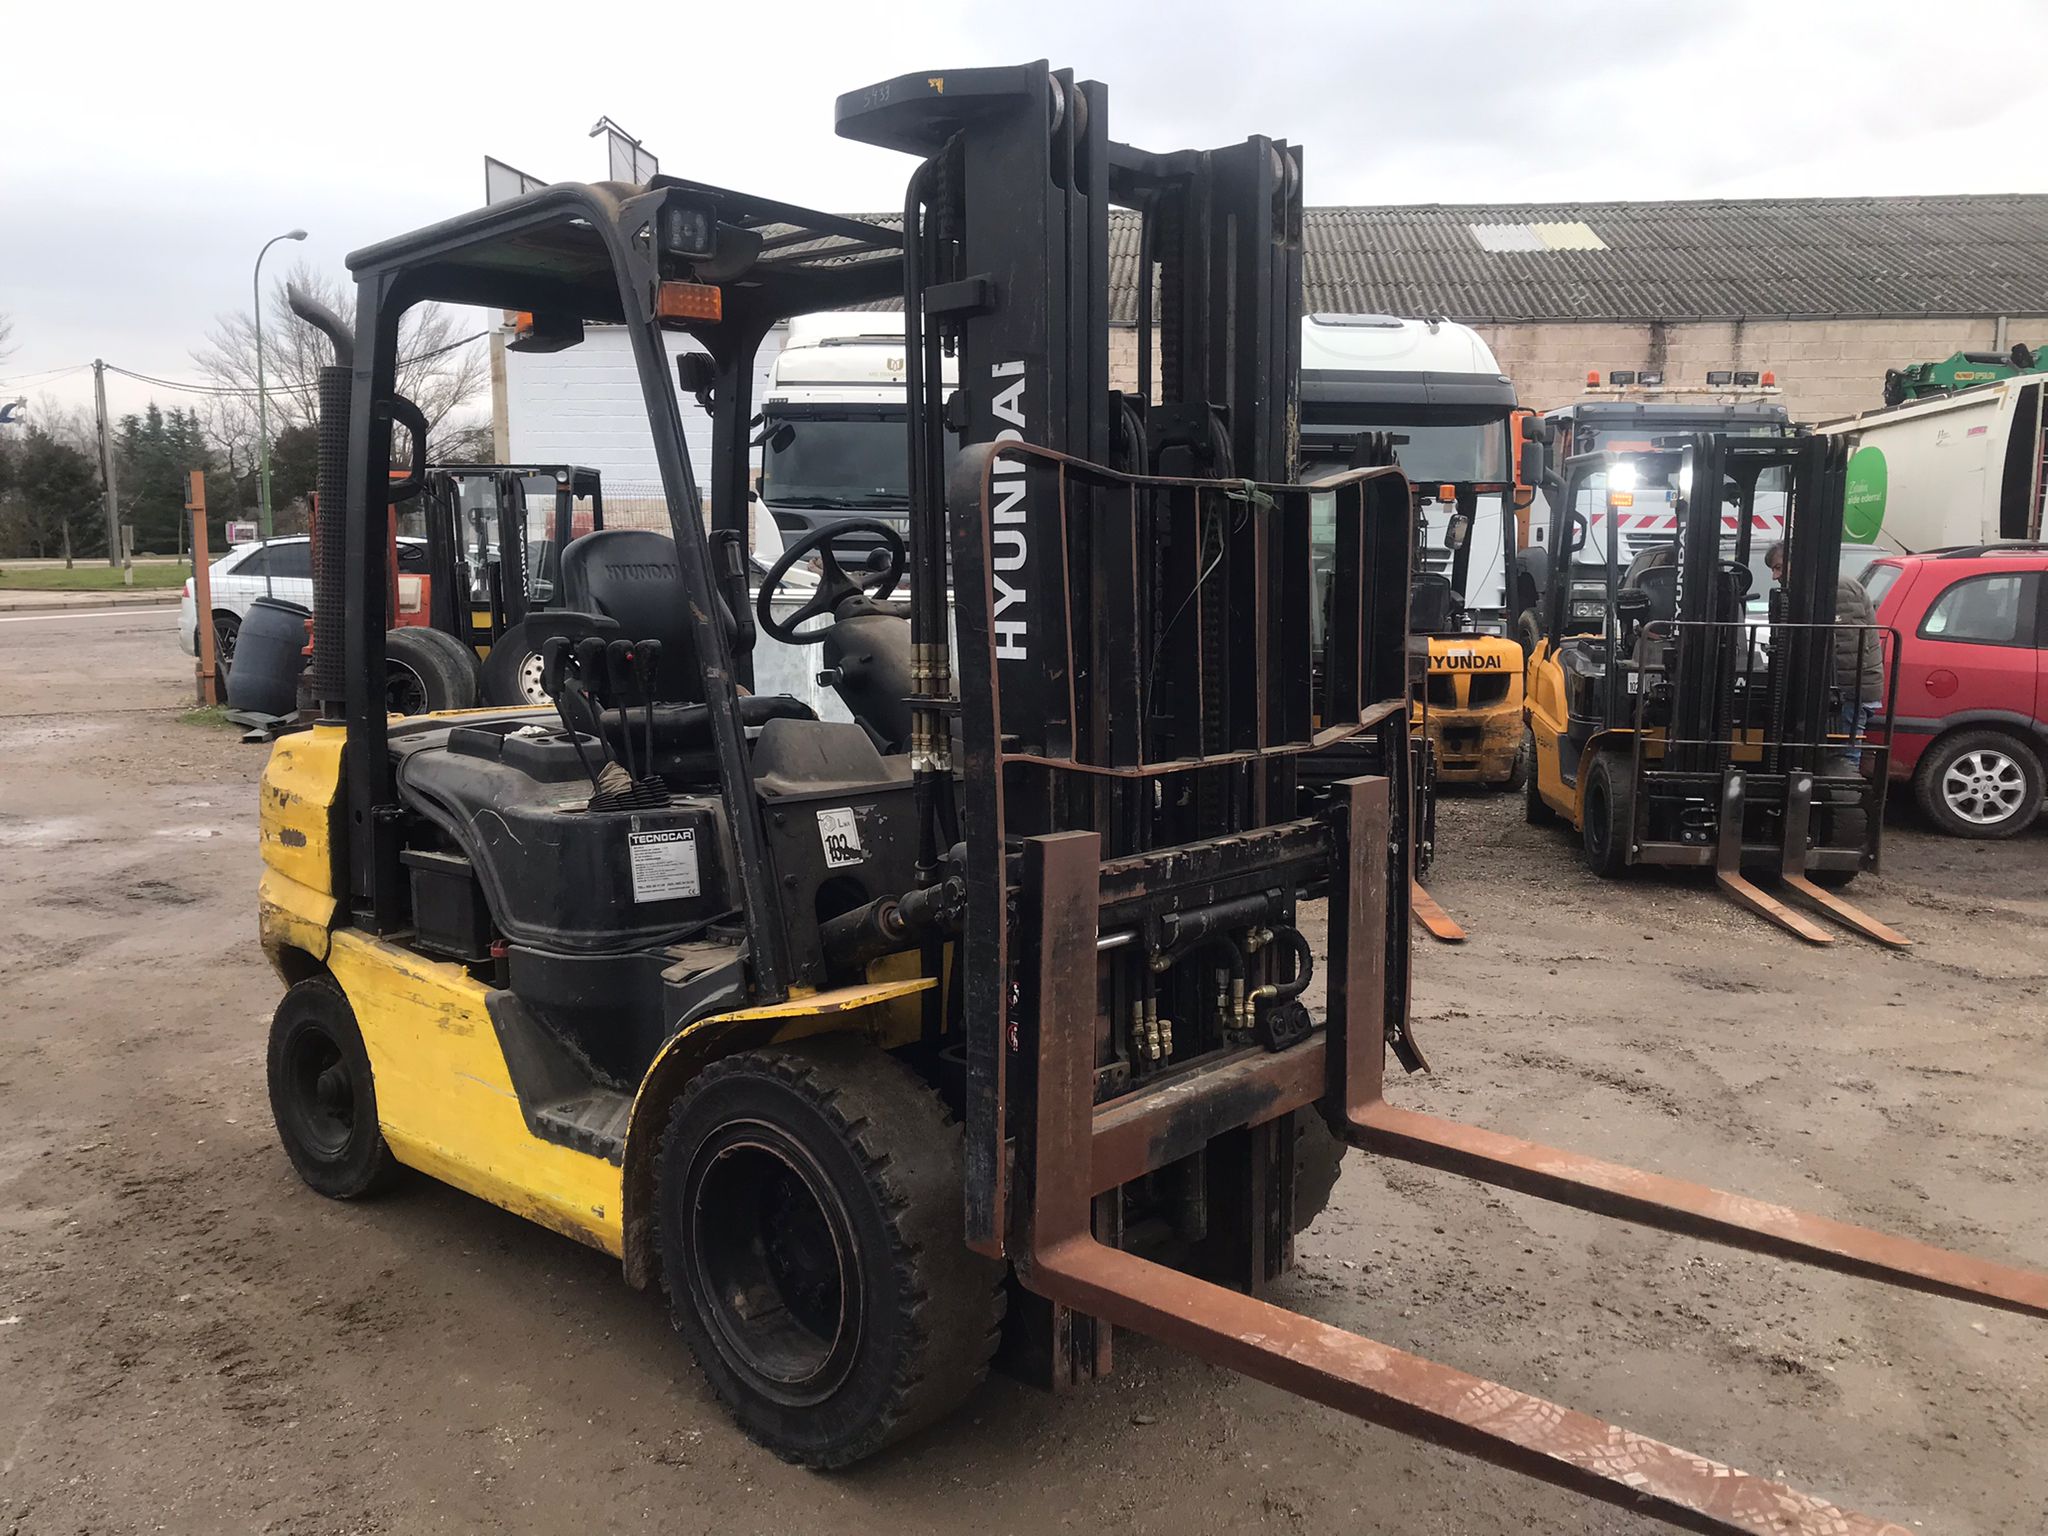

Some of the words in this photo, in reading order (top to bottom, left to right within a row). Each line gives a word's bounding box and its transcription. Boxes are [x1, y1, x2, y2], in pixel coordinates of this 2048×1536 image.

[992, 360, 1027, 660] HYUNDAI
[519, 523, 528, 597] HYUNDAI
[605, 563, 677, 580] HYUNDAI
[1673, 521, 1687, 636] HYUNDAI
[632, 831, 692, 844] TECNOCAR
